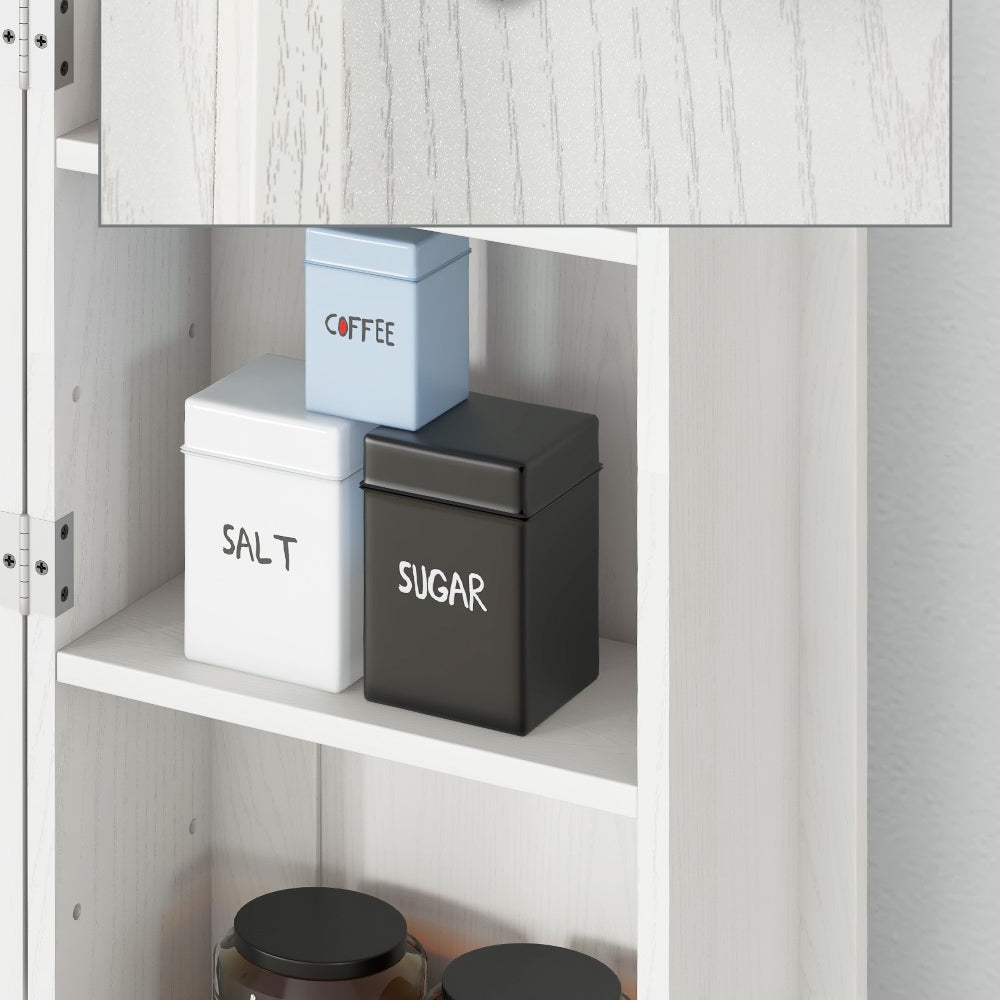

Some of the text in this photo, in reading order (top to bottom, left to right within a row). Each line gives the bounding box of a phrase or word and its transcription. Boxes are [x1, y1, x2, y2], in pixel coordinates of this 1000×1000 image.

[325, 313, 395, 347] COFFEE
[222, 523, 298, 571] SALT
[398, 561, 488, 612] SUGAR
